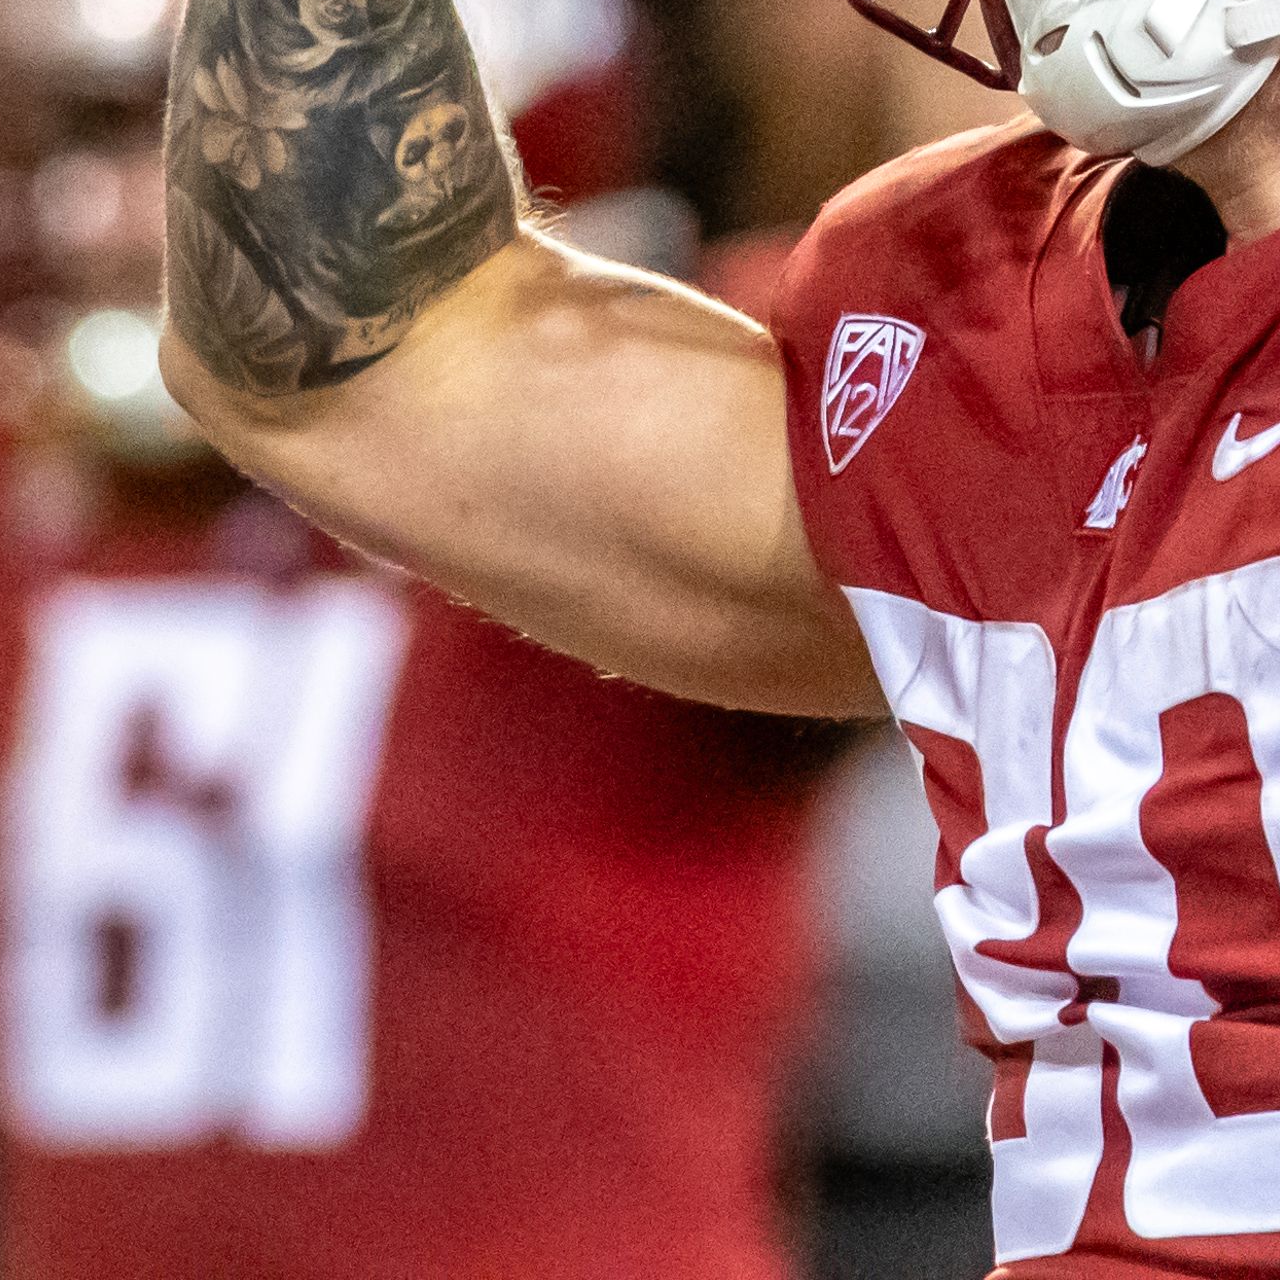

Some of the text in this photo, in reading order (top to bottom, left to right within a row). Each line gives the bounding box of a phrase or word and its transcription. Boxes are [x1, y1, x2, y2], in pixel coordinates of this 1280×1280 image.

[826, 321, 920, 412] PAC
[831, 382, 879, 437] 12
[0, 582, 412, 1144] 61
